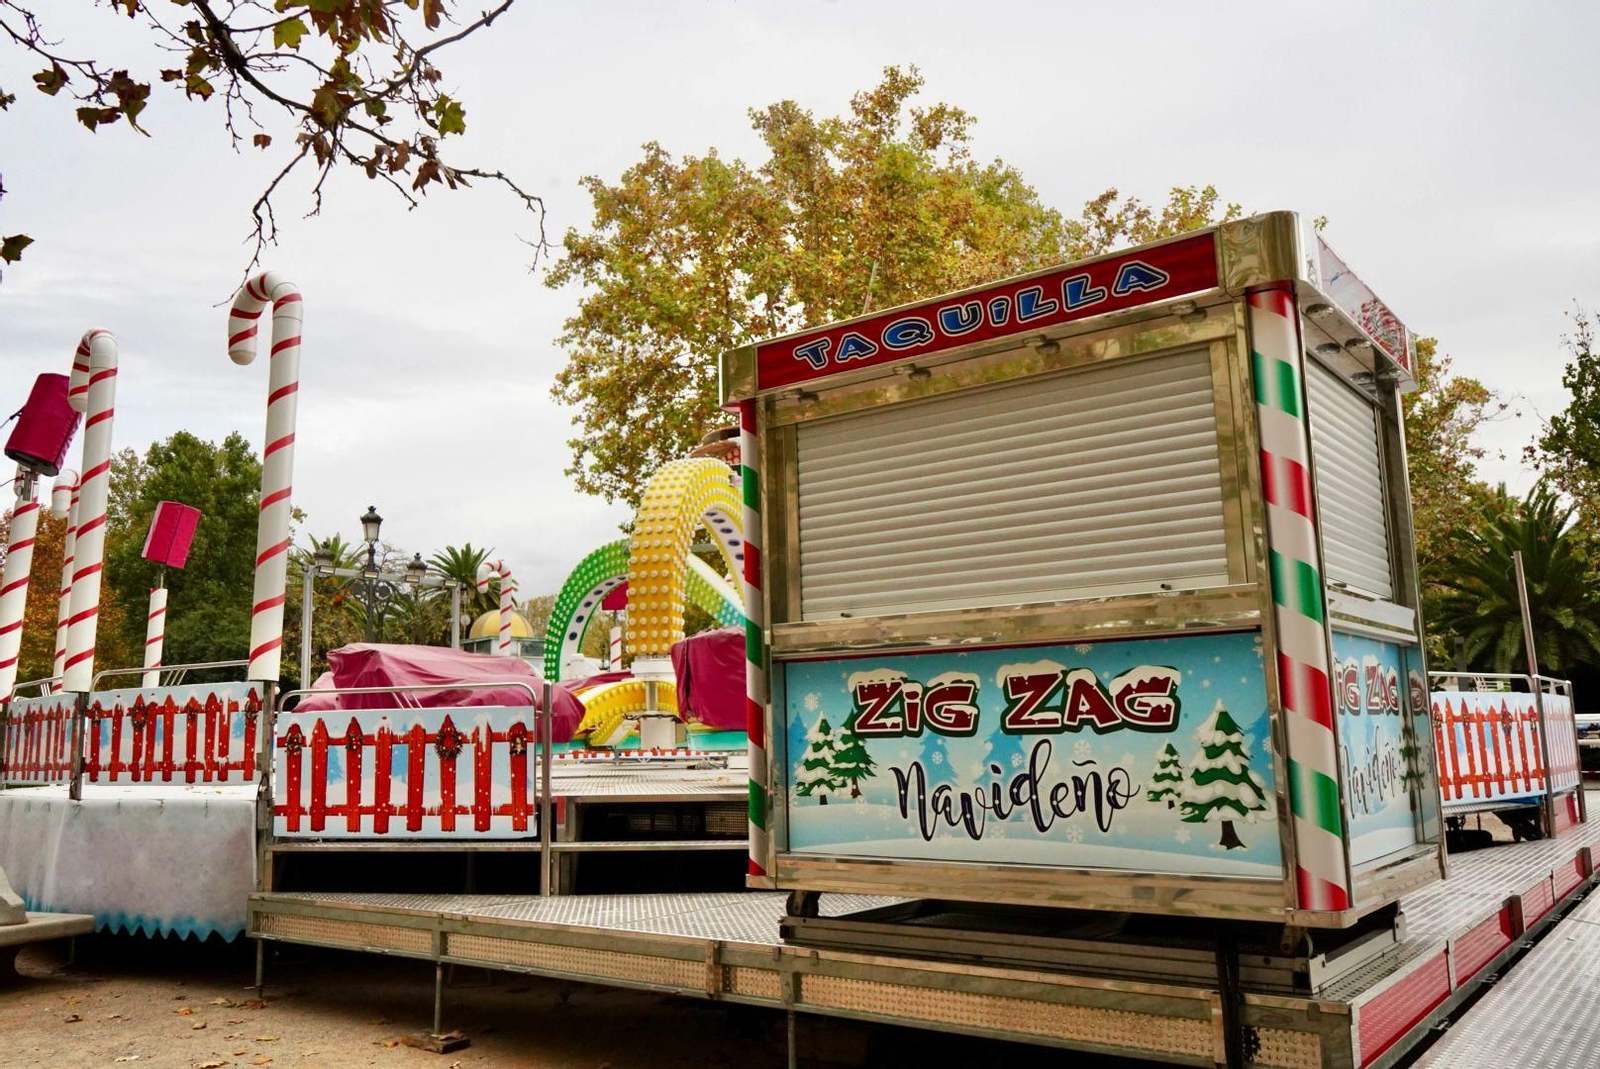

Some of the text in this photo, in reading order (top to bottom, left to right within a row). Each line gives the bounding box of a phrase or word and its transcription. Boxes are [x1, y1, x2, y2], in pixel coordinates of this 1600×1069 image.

[998, 662, 1182, 735] ZAG
[1335, 657, 1361, 714] iG
[1363, 656, 1400, 714] ZAG
[888, 738, 1141, 842] Navideño
